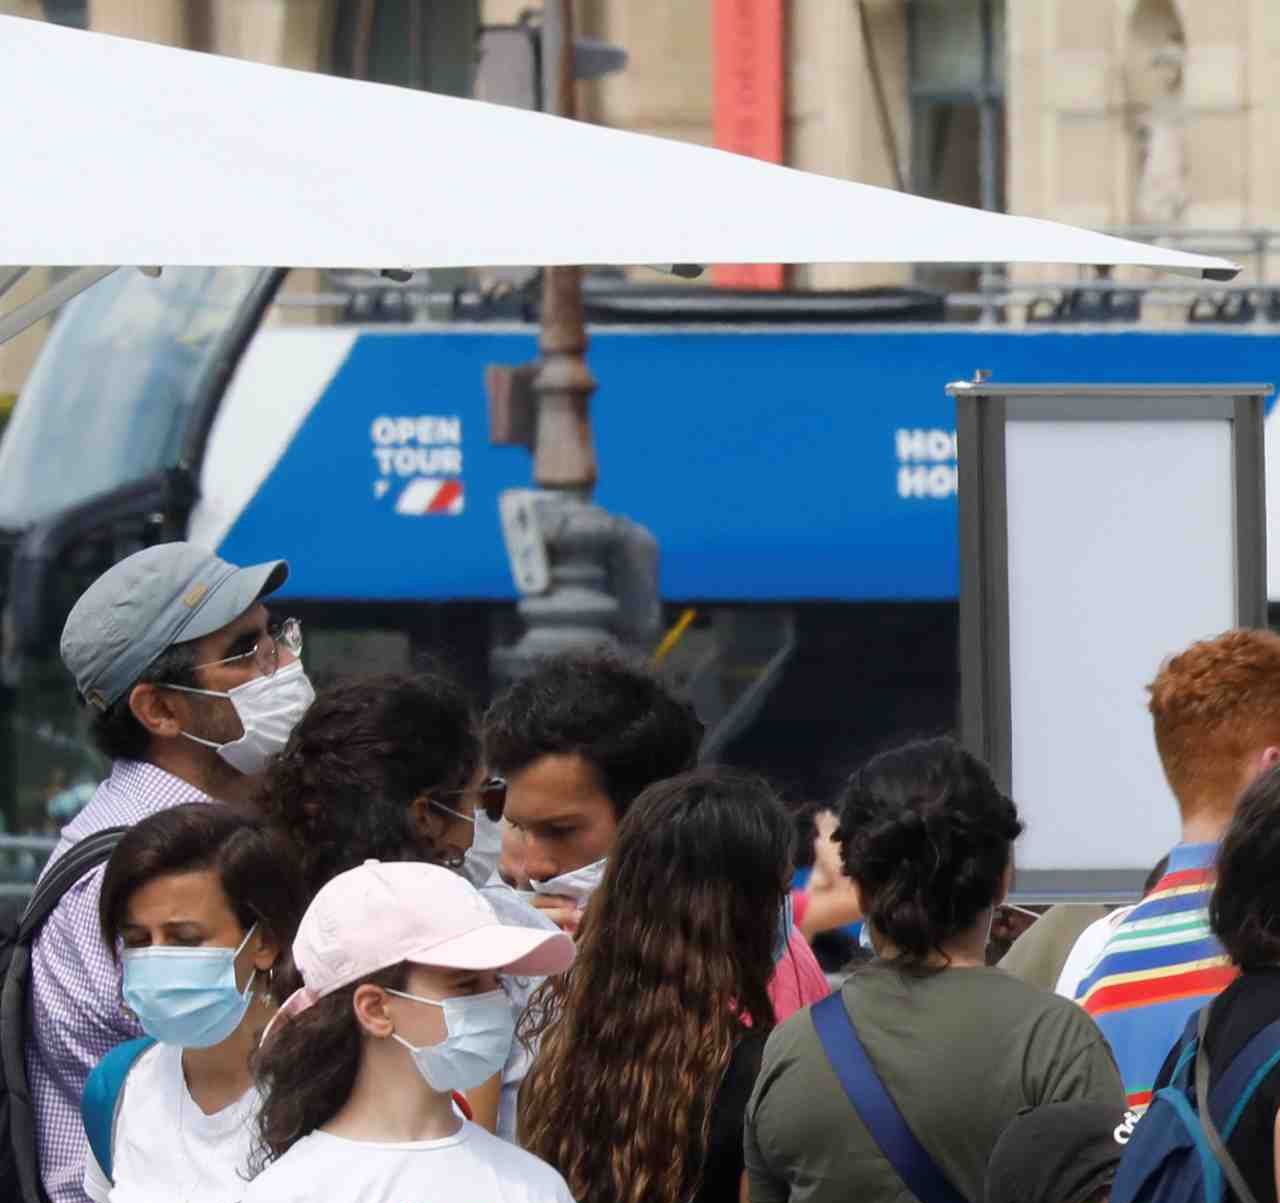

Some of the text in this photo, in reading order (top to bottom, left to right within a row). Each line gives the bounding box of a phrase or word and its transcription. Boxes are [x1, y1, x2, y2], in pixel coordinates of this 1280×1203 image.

[372, 416, 461, 445] OPEN
[896, 429, 958, 460] HO
[373, 447, 462, 476] TOUR
[897, 465, 959, 498] HO
